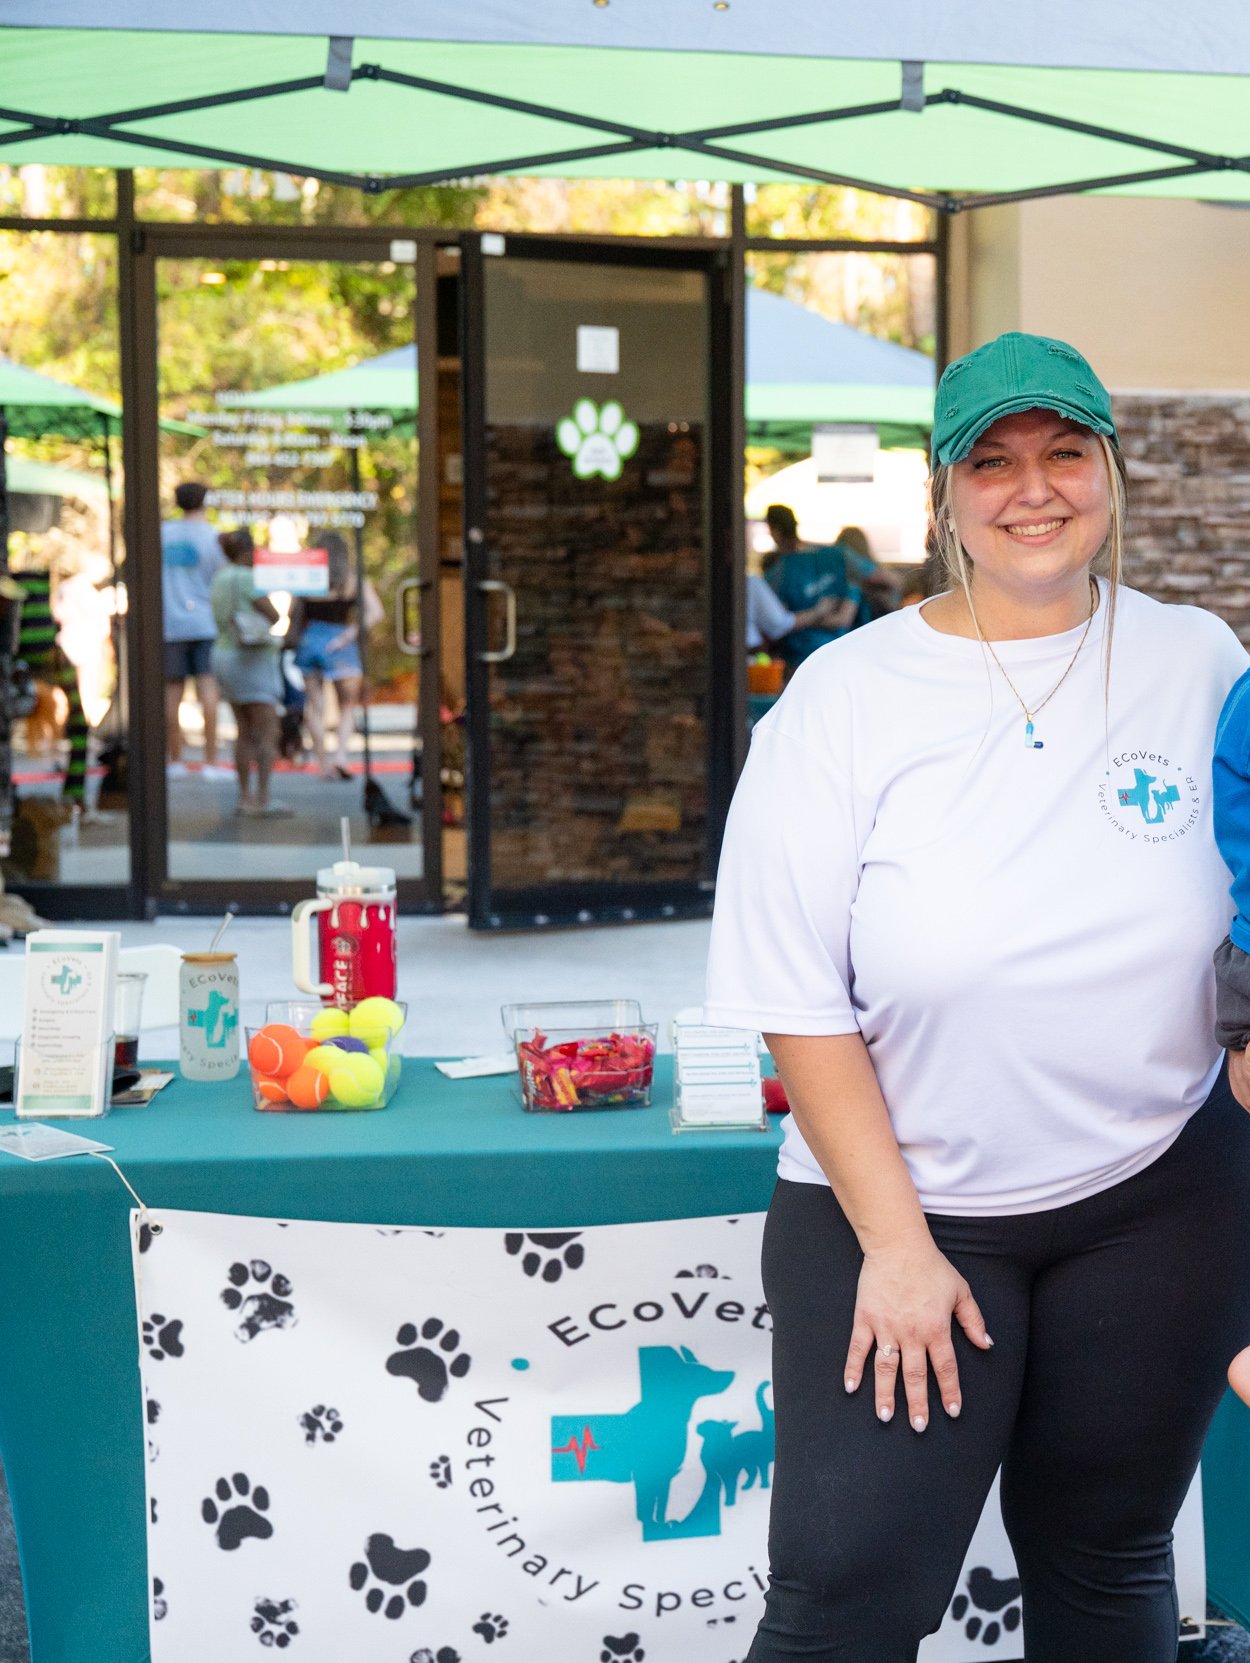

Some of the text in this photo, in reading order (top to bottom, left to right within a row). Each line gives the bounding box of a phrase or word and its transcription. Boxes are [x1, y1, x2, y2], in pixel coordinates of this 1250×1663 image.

[1112, 750, 1170, 768] ECoVets
[1097, 783, 1138, 840] Veterinary
[1143, 808, 1200, 844] Specialists
[1185, 776, 1198, 791] ER
[547, 1292, 774, 1347] ECoVet
[464, 1396, 600, 1602] Veterinary
